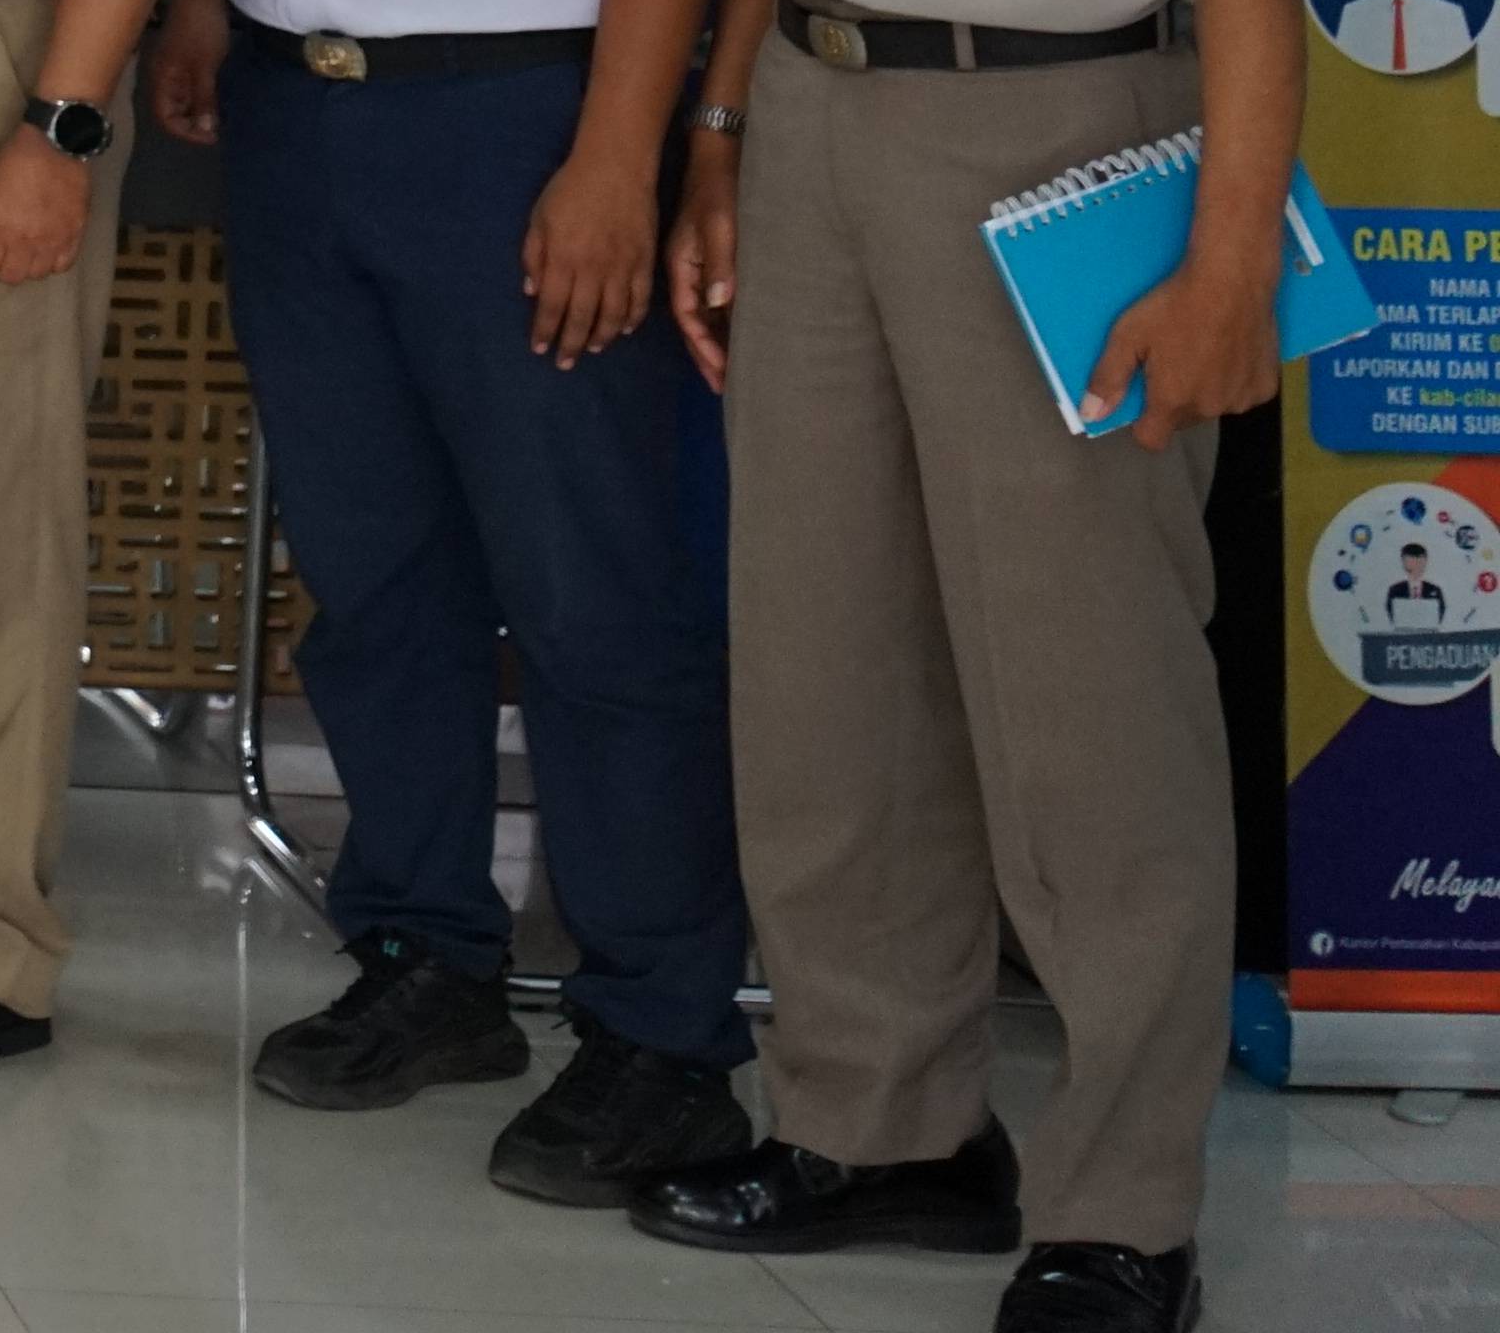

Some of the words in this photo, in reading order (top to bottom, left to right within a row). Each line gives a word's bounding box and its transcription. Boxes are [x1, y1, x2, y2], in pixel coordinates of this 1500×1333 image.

[1352, 227, 1452, 262] CARA
[1429, 278, 1491, 298] NAMA
[1390, 332, 1452, 352] KIRIM
[1458, 333, 1484, 353] KE
[1332, 359, 1441, 378] LAPORKAN
[1446, 360, 1490, 380] DAN
[1386, 386, 1413, 406] KE
[1371, 412, 1458, 434] DENGAN
